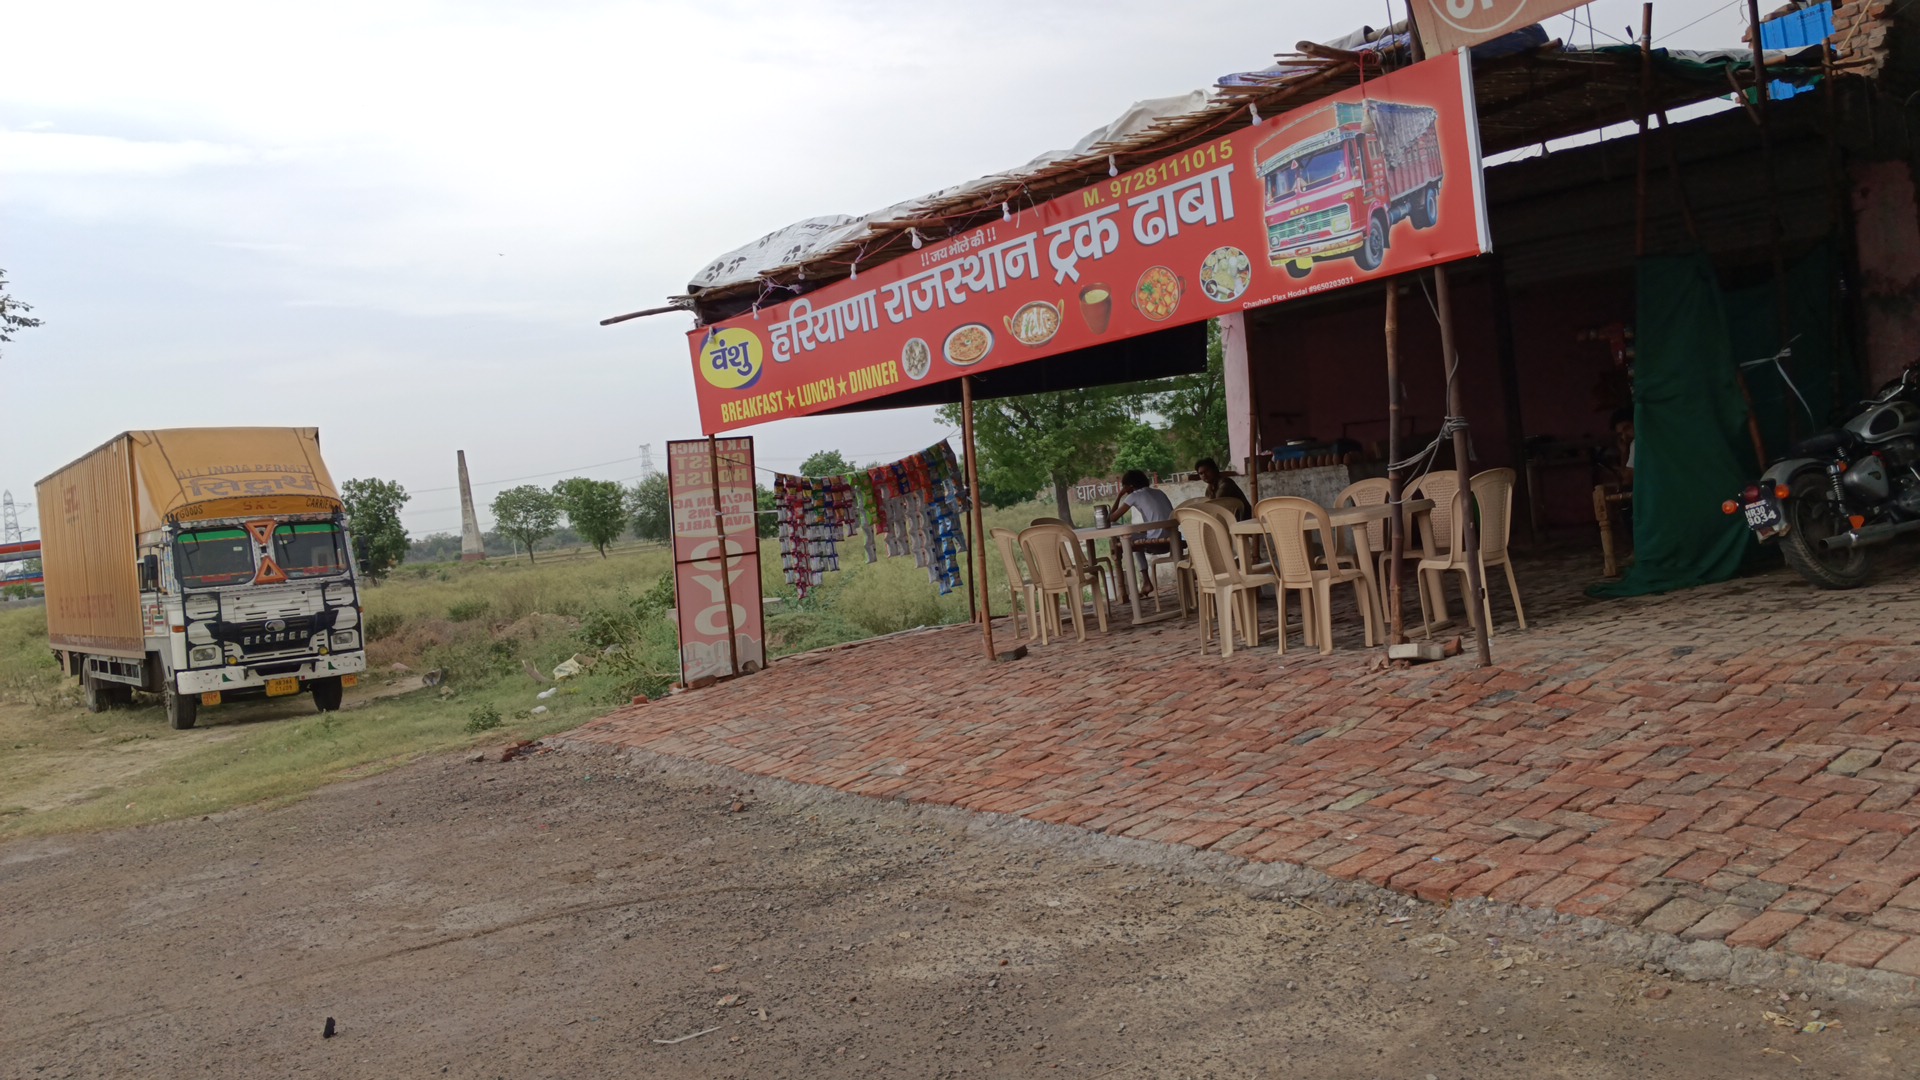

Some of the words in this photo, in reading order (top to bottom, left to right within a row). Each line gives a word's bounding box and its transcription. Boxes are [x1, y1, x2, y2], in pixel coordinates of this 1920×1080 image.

[1082, 188, 1106, 209] M.
[1110, 139, 1234, 197] 9728111015
[930, 247, 948, 262] जय
[949, 236, 970, 256] भोले
[970, 229, 985, 247] की
[768, 289, 879, 363] हरियाणा
[880, 232, 1040, 324] राजस्थान
[1043, 203, 1120, 286] ट्रक
[1127, 163, 1236, 246] ढाबा
[1243, 297, 1272, 309] Chauhan
[1272, 294, 1287, 303] Flex
[1287, 288, 1308, 299] Hodal
[710, 339, 753, 377] वंशु
[721, 390, 783, 424] BREAKFAST
[796, 375, 836, 408] LUNCH
[850, 360, 899, 395] DINNER
[208, 464, 250, 475] INDIA
[255, 463, 312, 474] PERMIT
[179, 504, 204, 519] GOODS
[305, 497, 333, 509] CARRIER
[243, 630, 309, 646] EICHER
